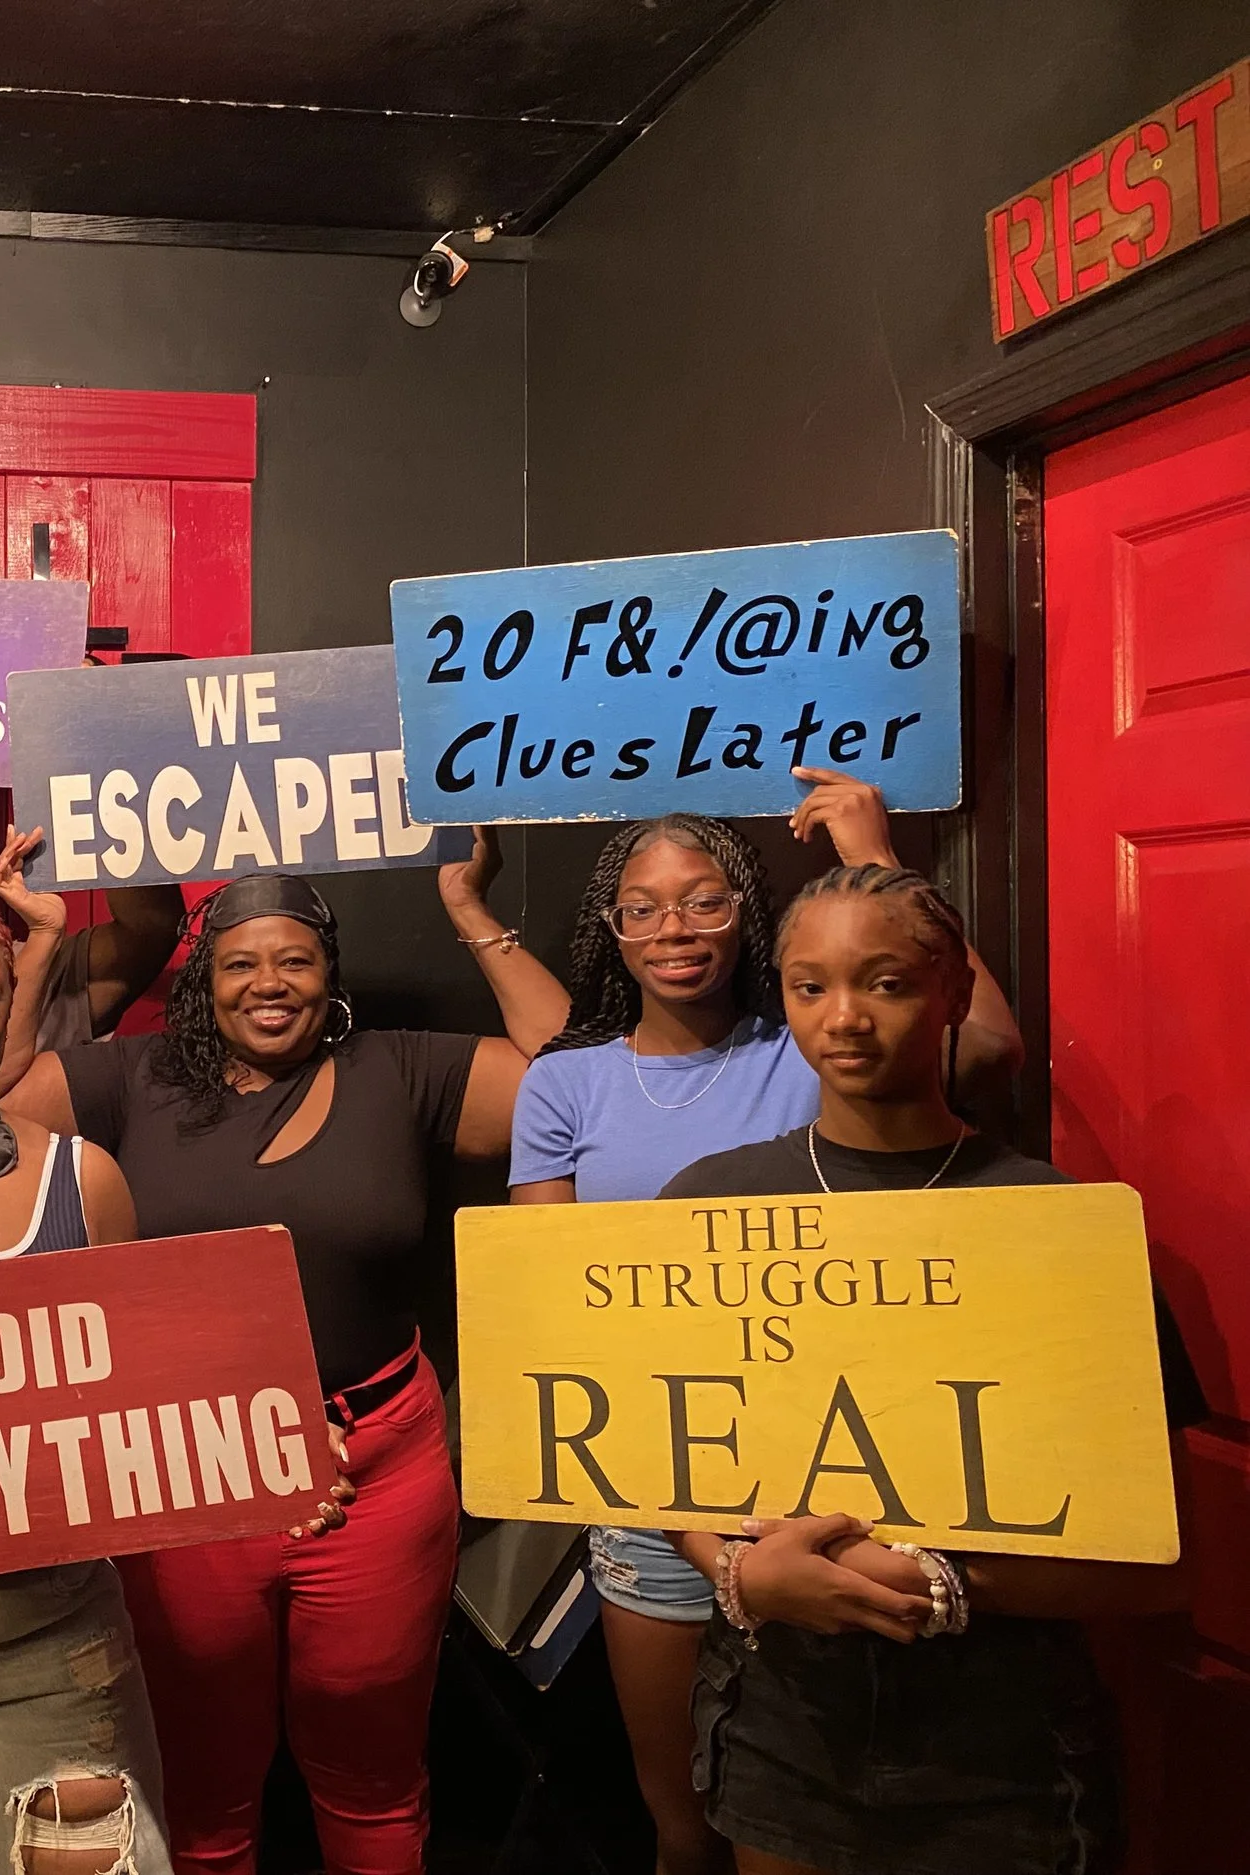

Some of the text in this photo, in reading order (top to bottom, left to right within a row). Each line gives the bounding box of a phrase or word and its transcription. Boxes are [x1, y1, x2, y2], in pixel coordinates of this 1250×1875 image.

[993, 75, 1234, 337] REST
[426, 609, 535, 684] 20
[185, 671, 282, 748] WE
[435, 700, 922, 793] Clues Later
[49, 749, 434, 882] ESCAPED
[691, 1204, 829, 1253] THE
[583, 1258, 963, 1310] STRUGGLE
[738, 1315, 796, 1364] IS
[522, 1371, 1073, 1538] REAL
